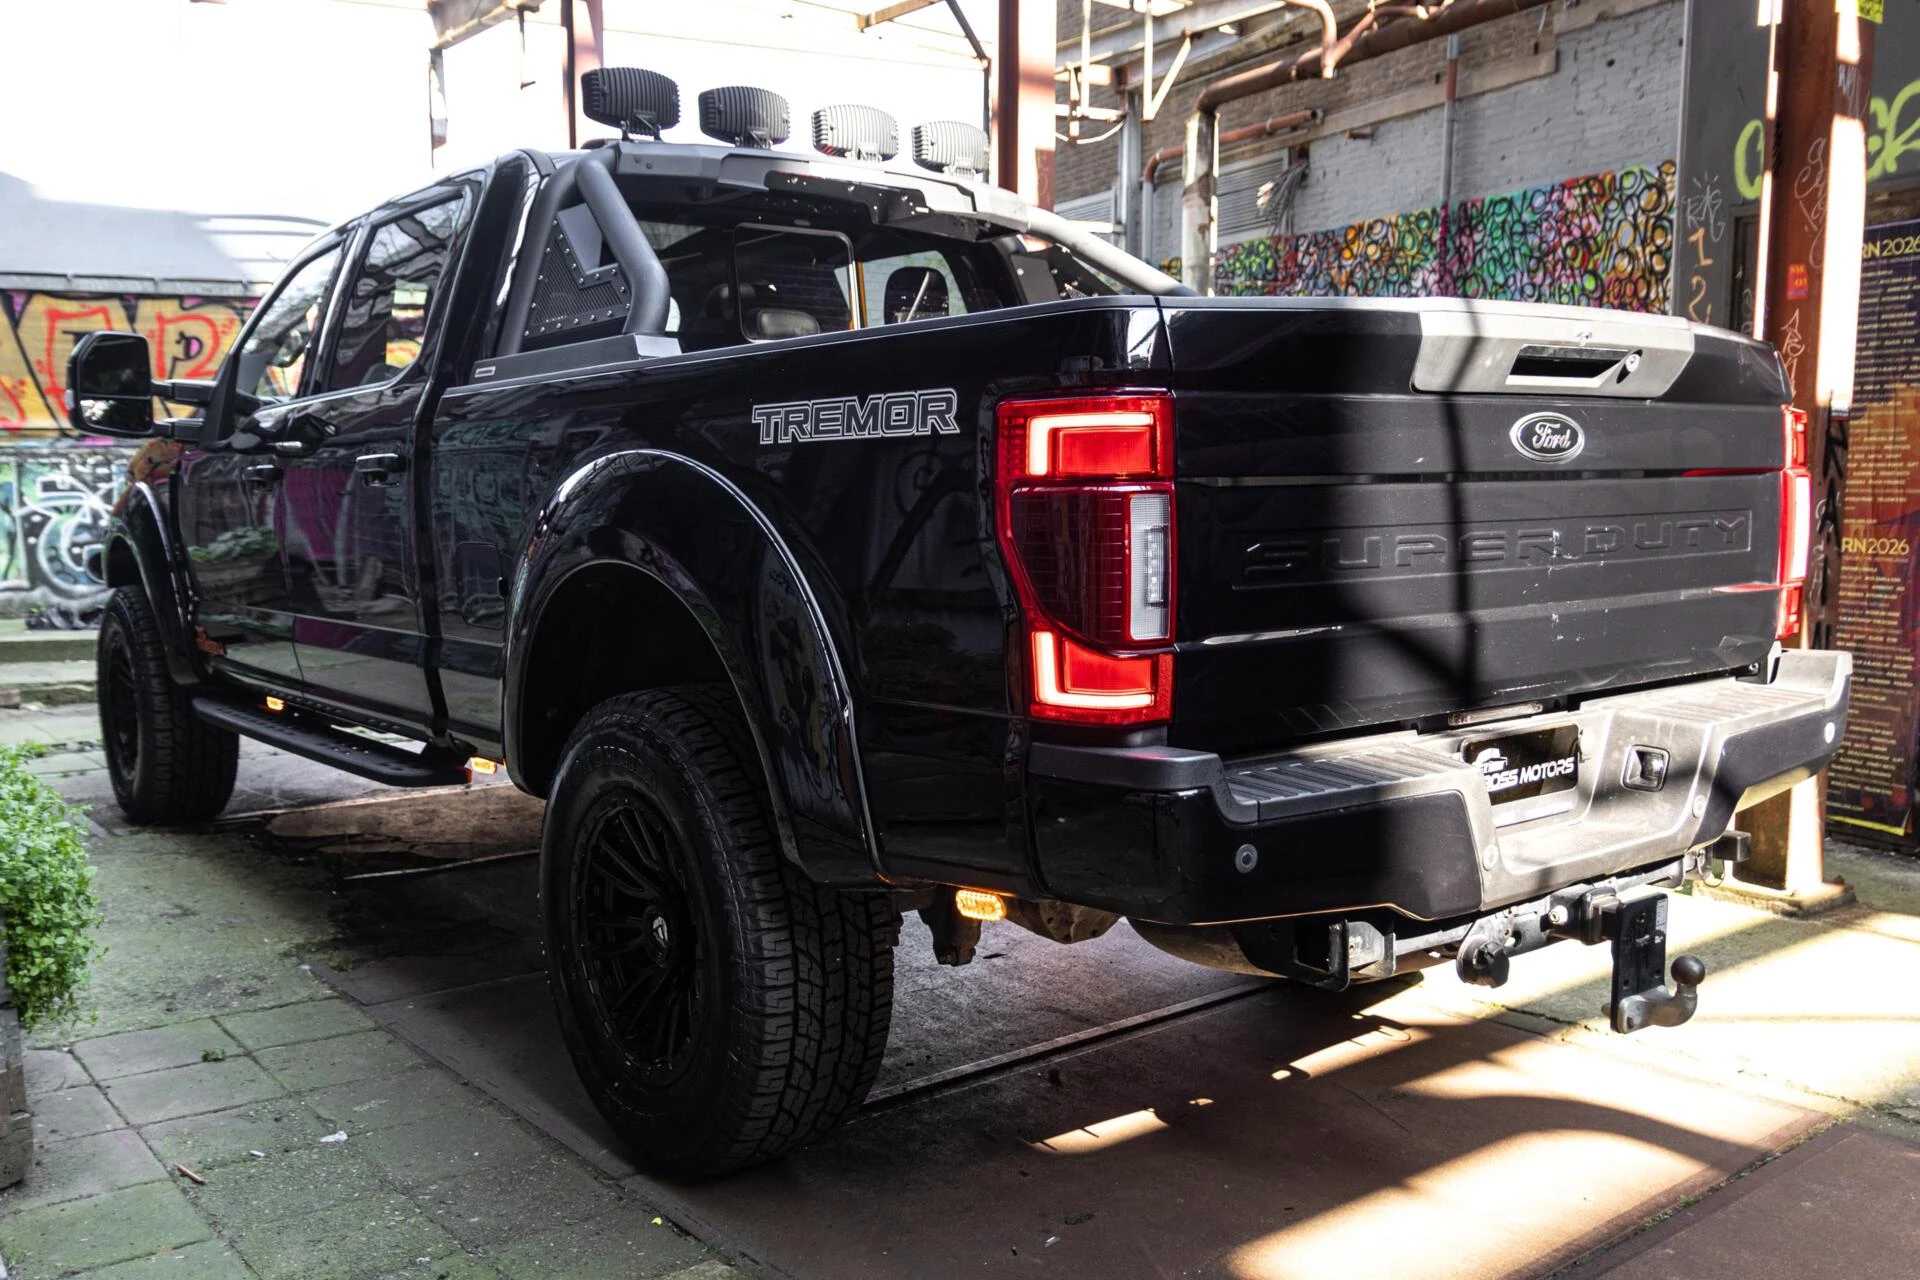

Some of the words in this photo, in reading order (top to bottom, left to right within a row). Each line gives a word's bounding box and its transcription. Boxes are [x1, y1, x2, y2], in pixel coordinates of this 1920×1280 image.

[751, 387, 961, 445] TREMOR
[1532, 421, 1571, 449] Ford
[1244, 529, 1558, 577] SUPER
[1585, 517, 1746, 554] DUTY
[1519, 756, 1575, 784] MOTORS
